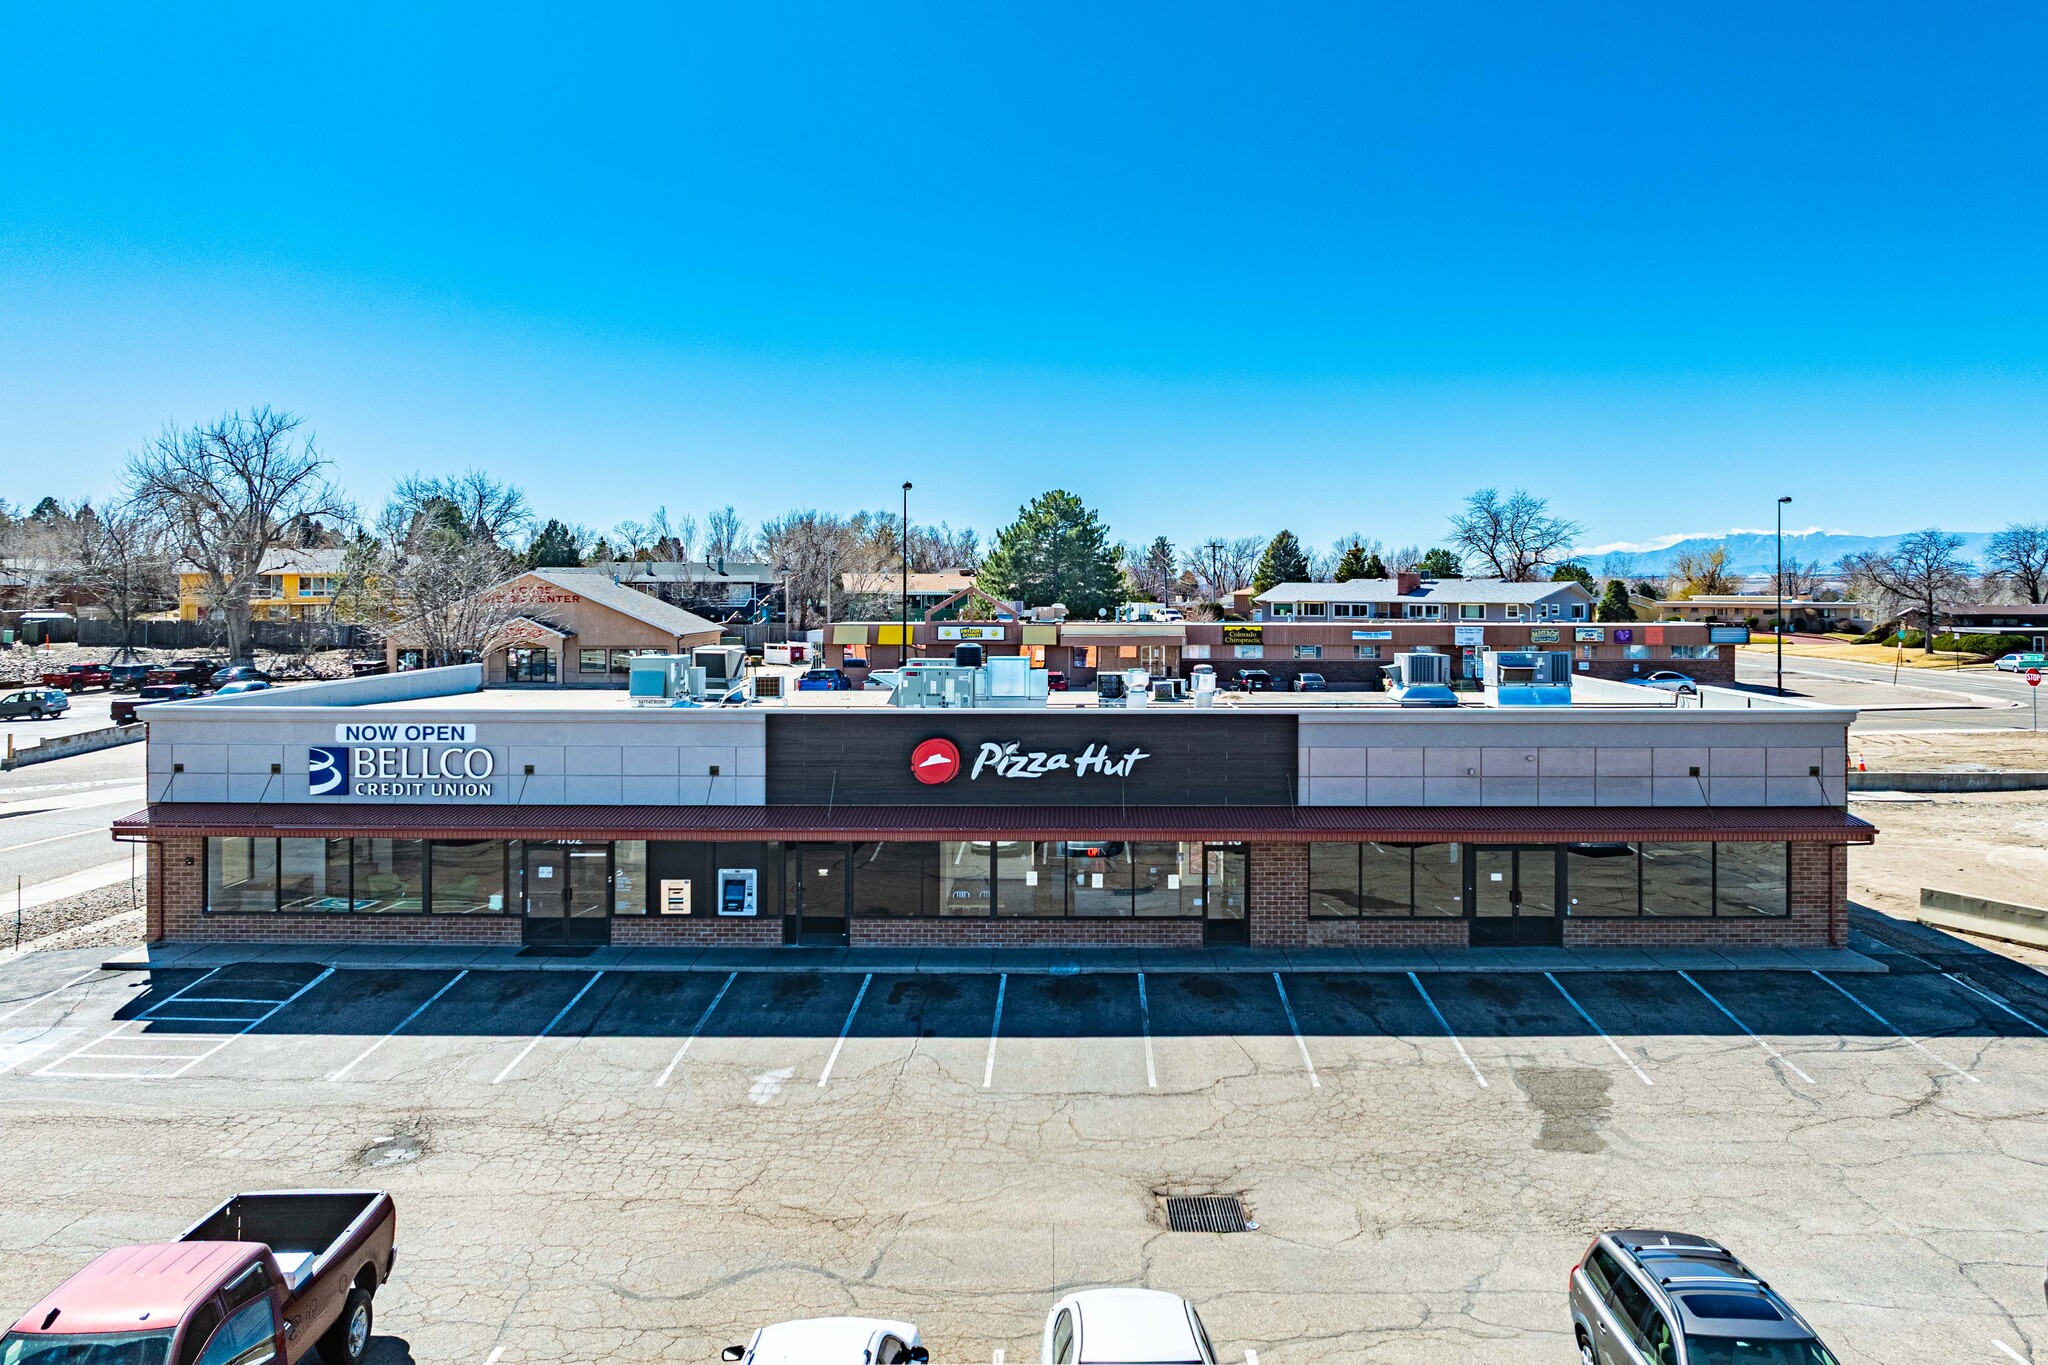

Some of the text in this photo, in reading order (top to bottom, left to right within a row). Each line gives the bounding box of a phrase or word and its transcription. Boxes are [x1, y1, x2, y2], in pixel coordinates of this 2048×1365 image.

[530, 595, 581, 603] CENTER
[346, 725, 465, 741] NOW OPEN
[354, 747, 494, 780] BELLCO
[970, 741, 1150, 781] Pizza Hut
[355, 782, 492, 797] CREDIT UNION
